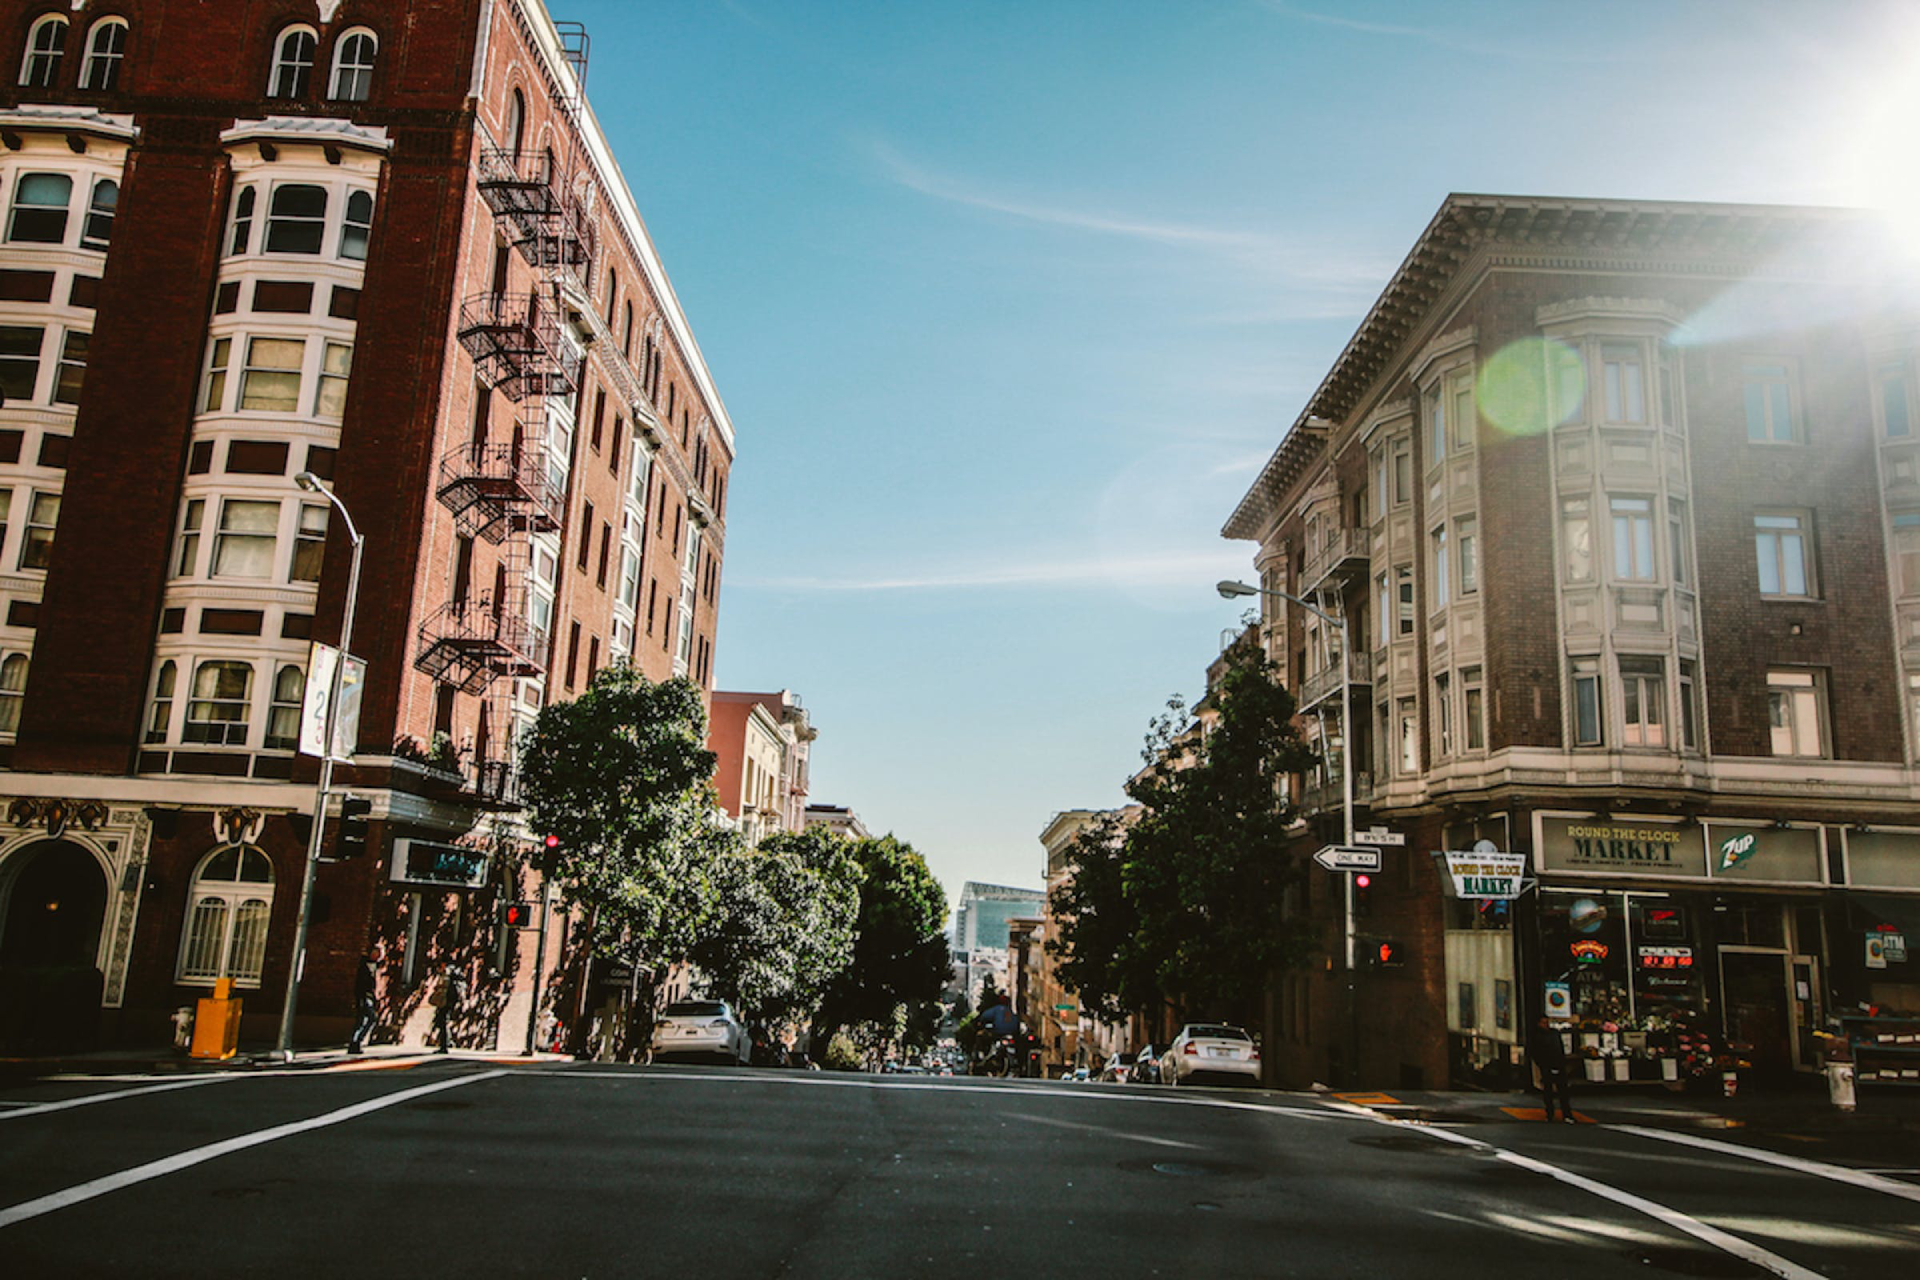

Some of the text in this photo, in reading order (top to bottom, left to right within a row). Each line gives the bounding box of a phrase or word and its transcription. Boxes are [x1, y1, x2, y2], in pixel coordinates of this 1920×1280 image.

[1364, 834, 1396, 842] BUSH
[1567, 825, 1681, 843] ROUND THE CLOCK
[1574, 838, 1674, 861] MARKET
[1336, 853, 1374, 863] ONE WAY
[1462, 876, 1513, 895] MARKET
[1883, 935, 1905, 950] ATM
